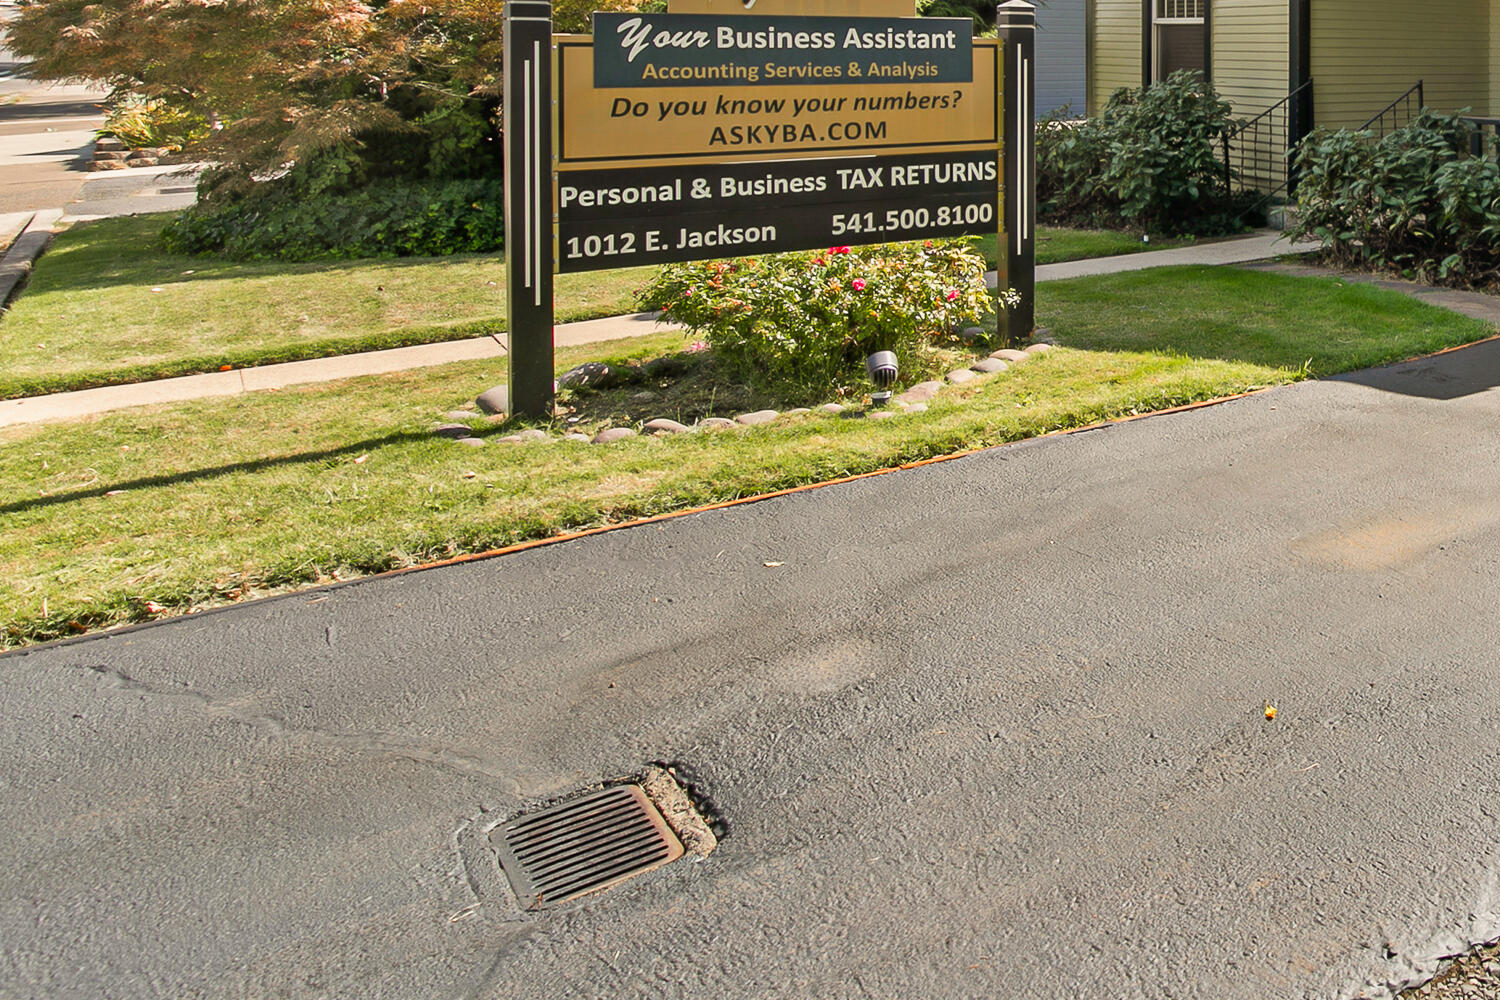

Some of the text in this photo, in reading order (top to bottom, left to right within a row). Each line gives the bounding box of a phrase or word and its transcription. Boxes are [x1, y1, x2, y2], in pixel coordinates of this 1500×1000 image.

[616, 17, 956, 63] Your Business Assistant
[641, 60, 938, 82] Accounting Services & Analysis
[610, 89, 963, 122] Do you know your numbers?
[708, 120, 888, 147] ASKYBA.COM
[560, 160, 997, 208] Personal & Business TAX RETURNS
[831, 202, 993, 236] 541.500.8100
[566, 223, 777, 260] 1012 E. Jackson
